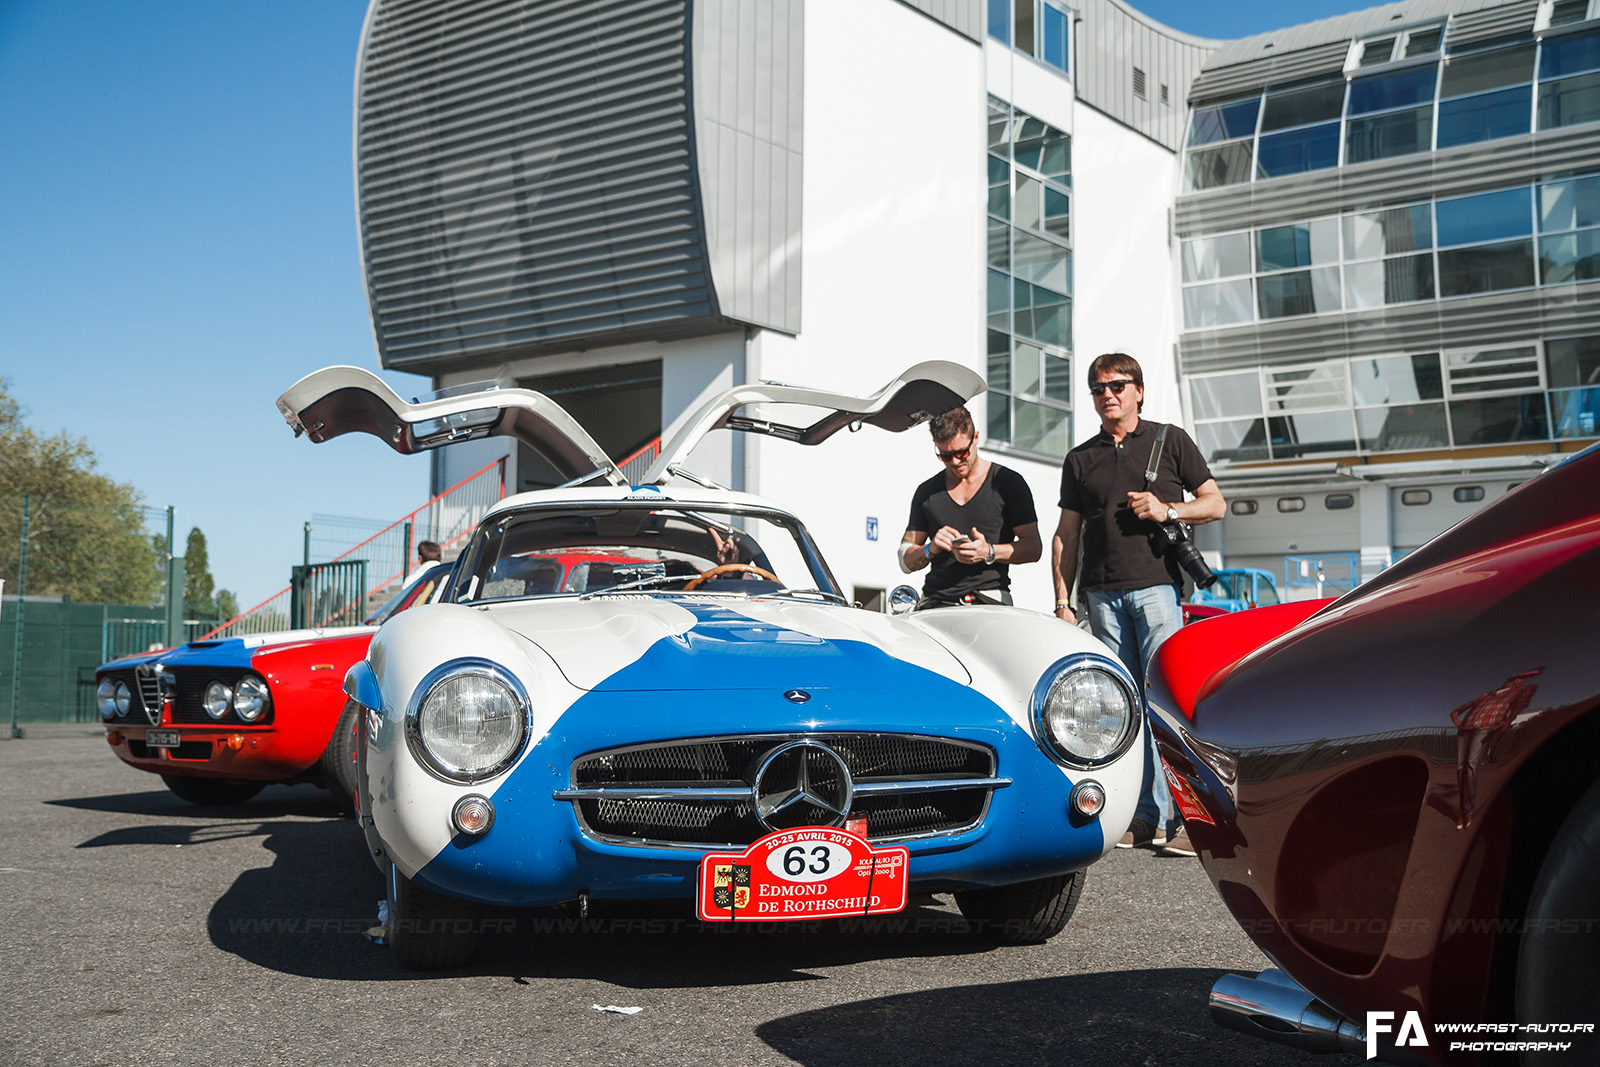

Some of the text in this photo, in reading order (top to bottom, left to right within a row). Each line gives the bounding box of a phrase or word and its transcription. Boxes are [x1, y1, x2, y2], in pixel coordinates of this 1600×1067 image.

[766, 832, 853, 850] 20-25 AVRIL 2015
[783, 845, 831, 876] 63
[874, 868, 890, 876] 2000
[759, 883, 828, 897] EDMOND
[758, 901, 780, 913] DE
